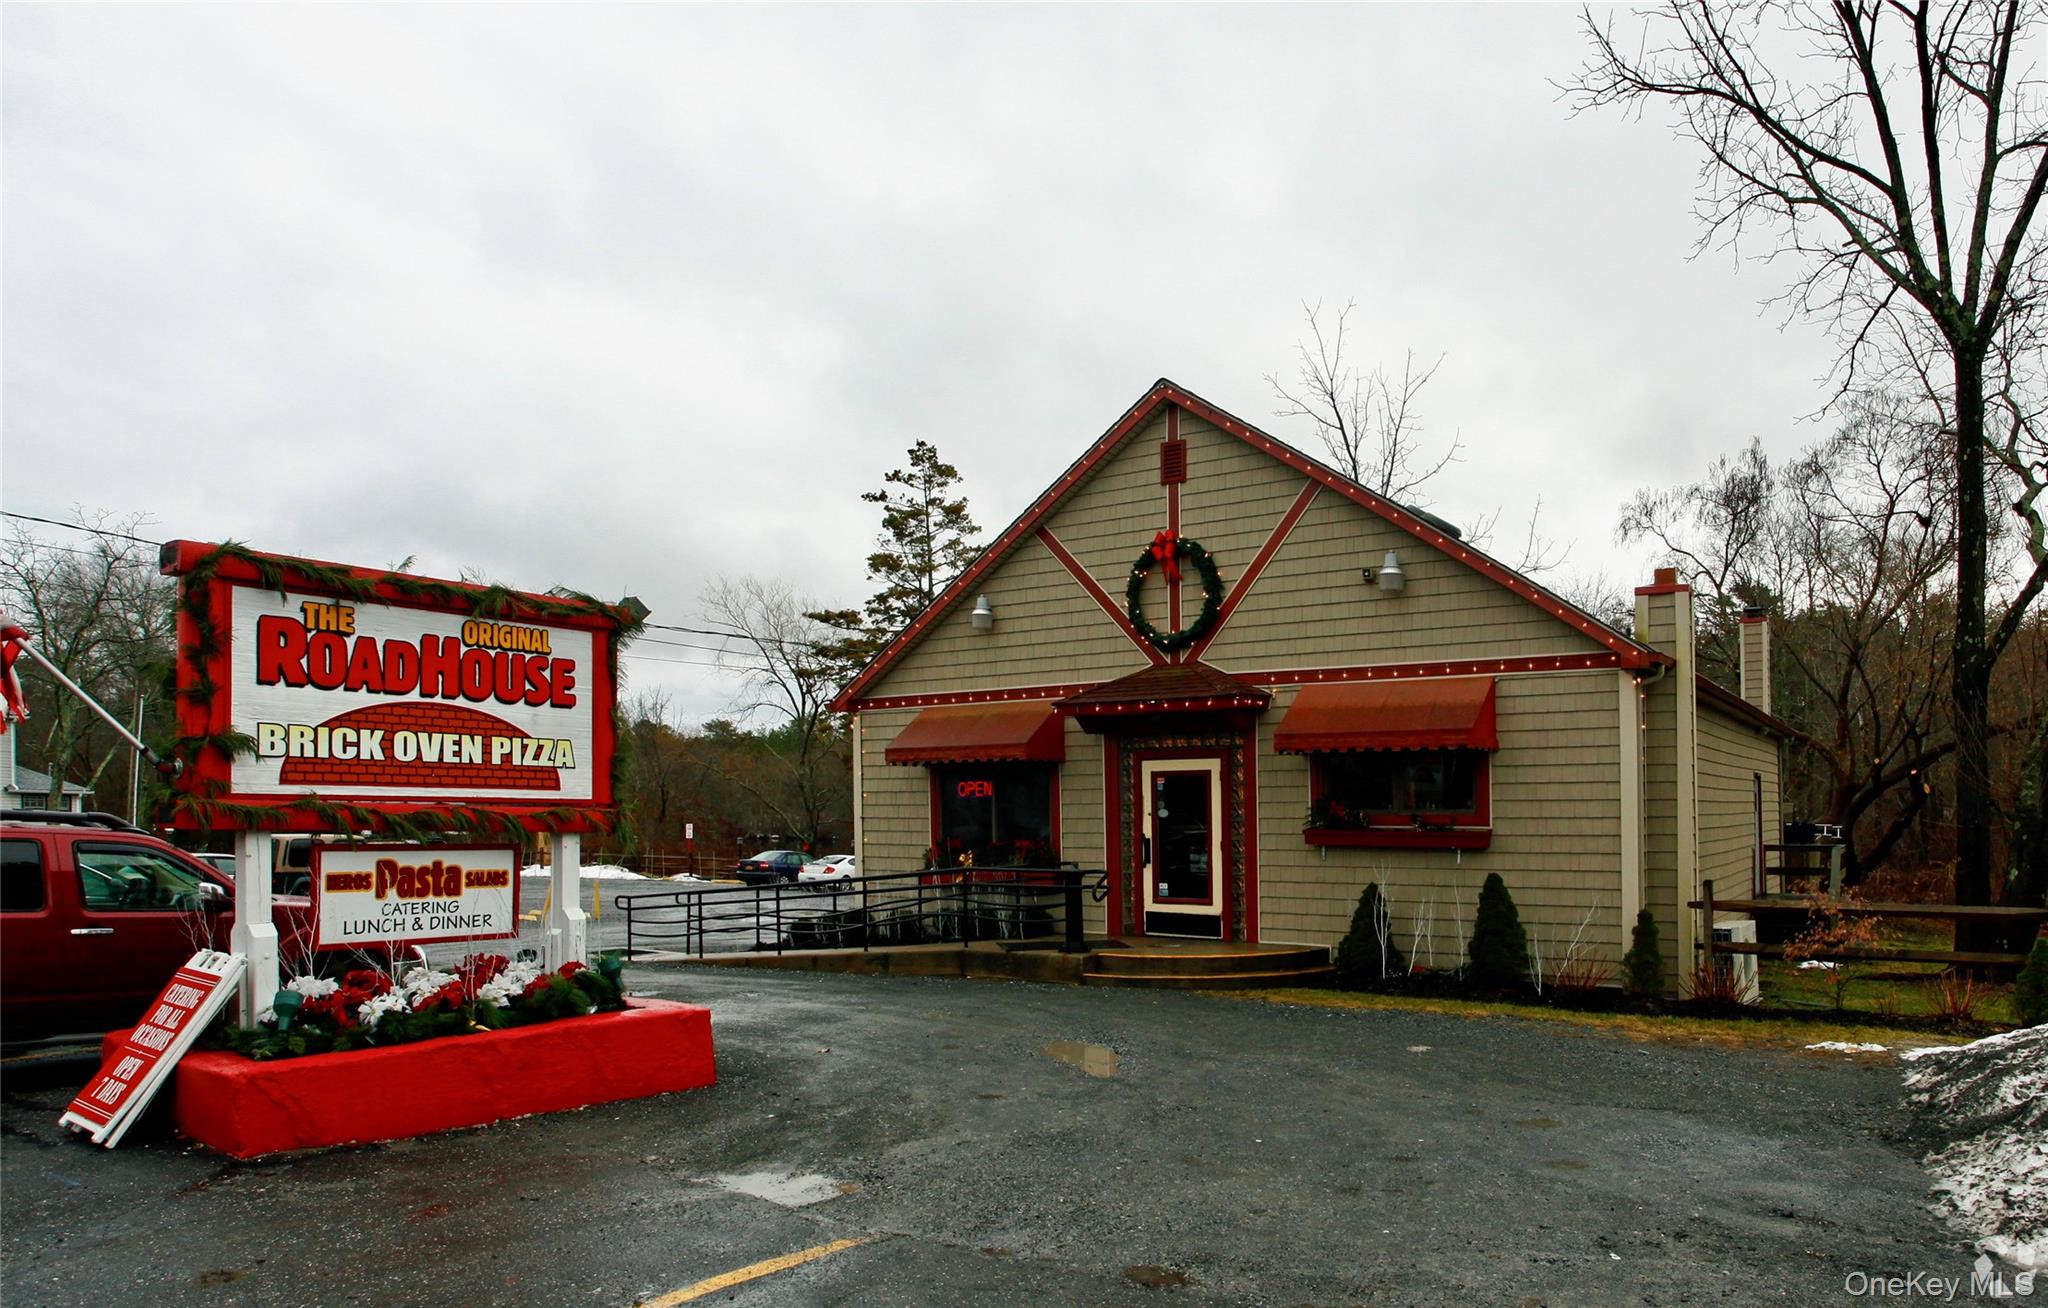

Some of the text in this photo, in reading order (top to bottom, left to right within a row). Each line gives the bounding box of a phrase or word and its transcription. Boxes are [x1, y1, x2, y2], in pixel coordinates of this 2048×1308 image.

[302, 601, 356, 635] THE
[462, 620, 552, 655] ORIGINAL
[258, 722, 576, 769] BRICK OVEN PIZZA
[957, 780, 993, 798] OPEN
[374, 859, 463, 900] Pasta
[464, 870, 510, 888] SALADS
[381, 900, 460, 916] CATERING
[343, 914, 493, 935] LUNCH & DINNER
[163, 983, 205, 1009] CATERING
[150, 1004, 186, 1030] FOR ALL
[130, 1023, 175, 1052] OCCASIONS
[112, 1055, 145, 1081] OPEN
[91, 1077, 128, 1105] 7 DAYS
